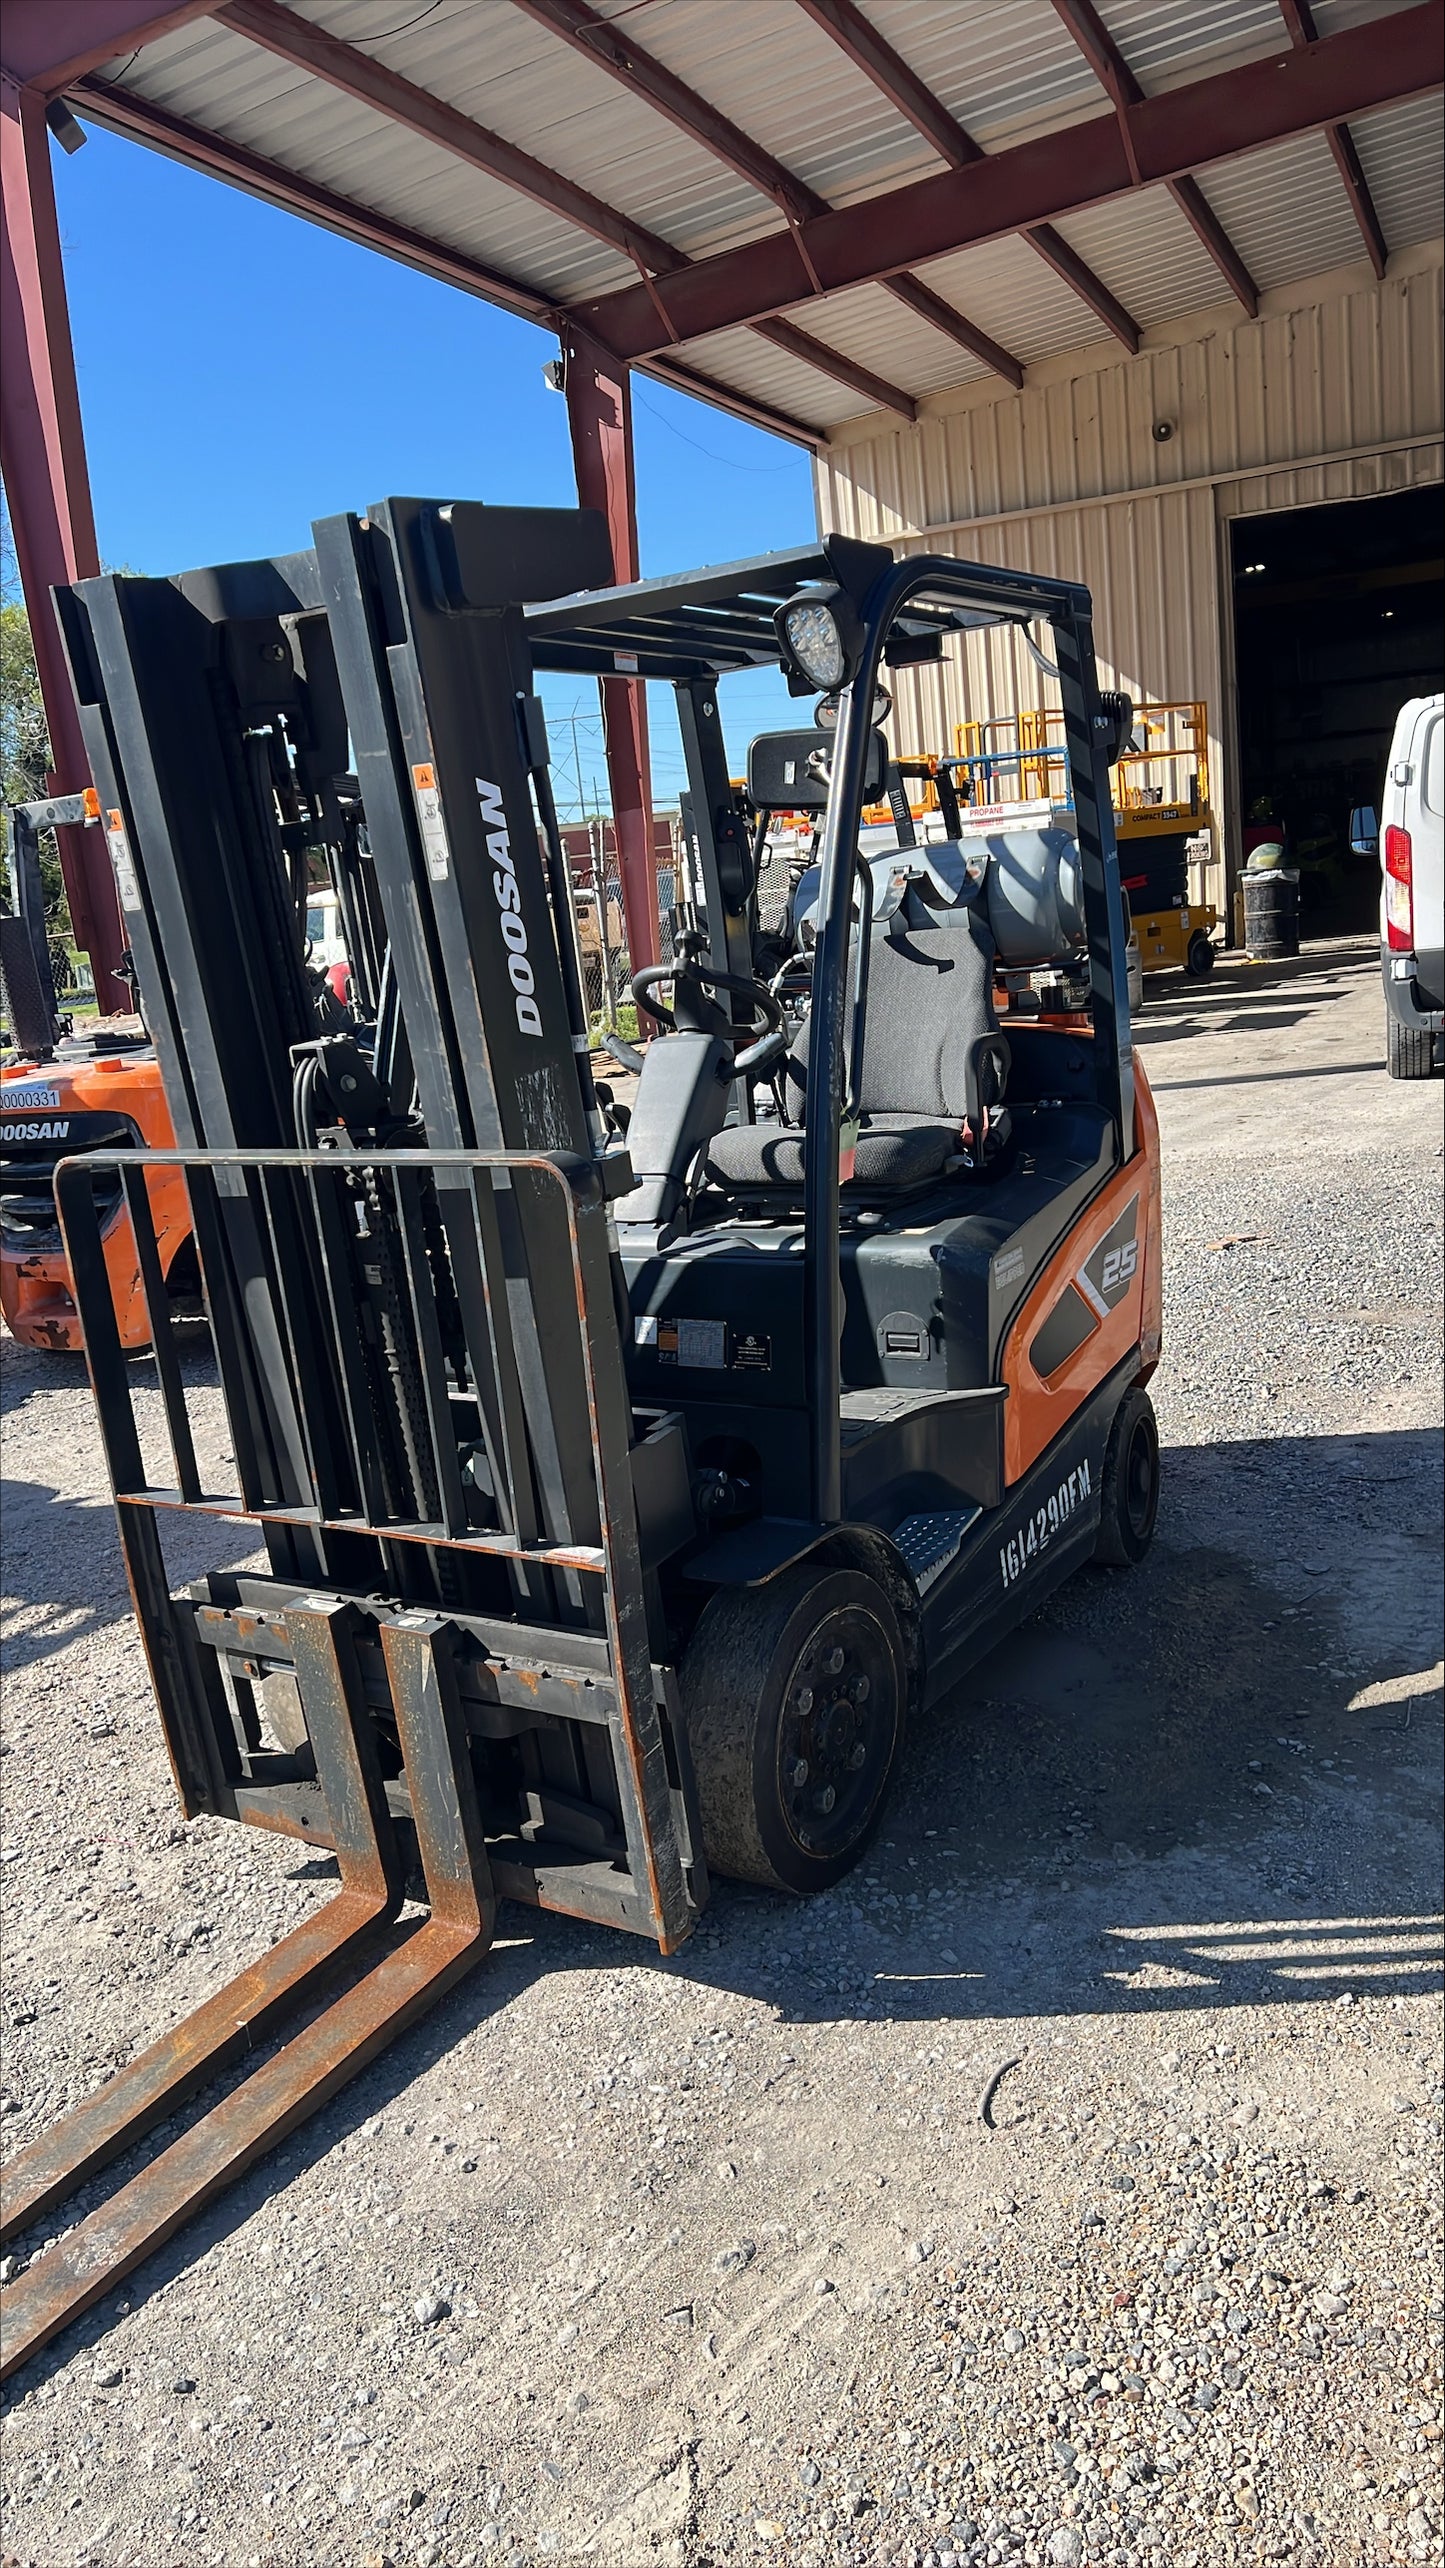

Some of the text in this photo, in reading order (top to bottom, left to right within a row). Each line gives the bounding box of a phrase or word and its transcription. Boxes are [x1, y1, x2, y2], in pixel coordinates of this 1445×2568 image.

[969, 806, 1004, 817] PROPANE
[1132, 812, 1160, 822] COMPACT
[475, 777, 544, 1037] DOOSAN
[1103, 1239, 1138, 1293] 25
[1000, 1458, 1091, 1588] 1614290FM
